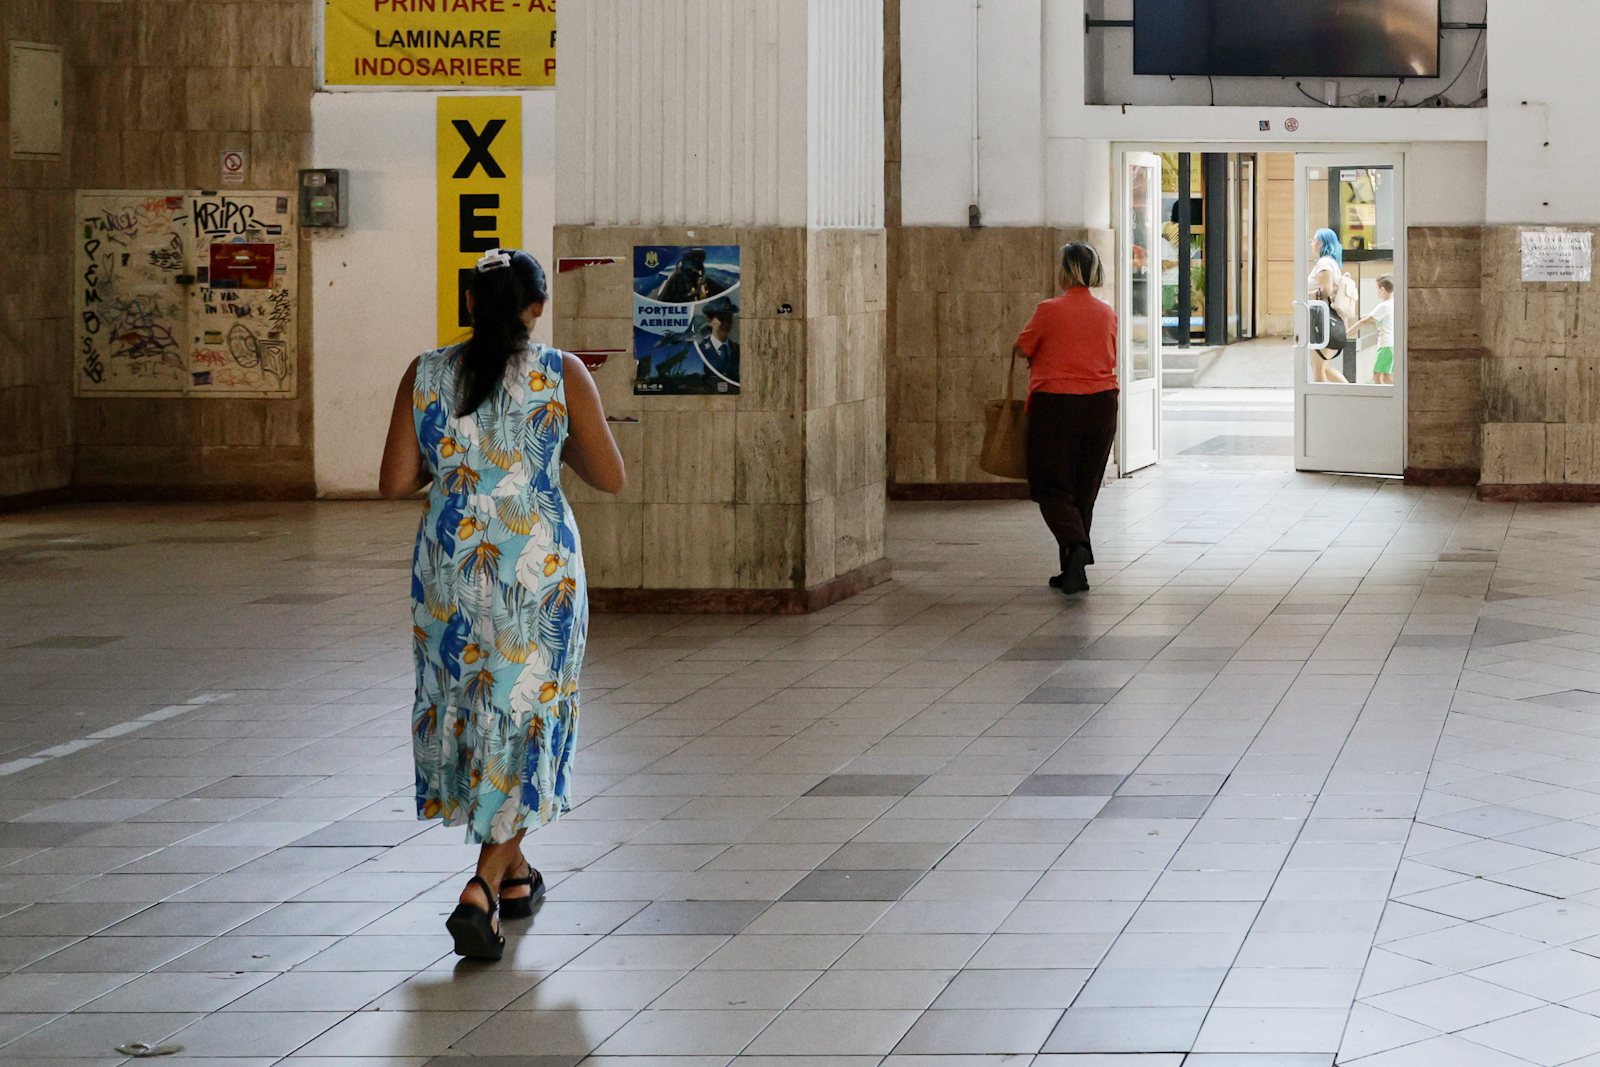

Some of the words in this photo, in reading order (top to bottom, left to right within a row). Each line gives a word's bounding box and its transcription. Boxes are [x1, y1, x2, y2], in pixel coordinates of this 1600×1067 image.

[375, 30, 501, 48] LAMINARE
[354, 58, 522, 76] INDOSARIERE
[638, 306, 688, 316] FORȚELE
